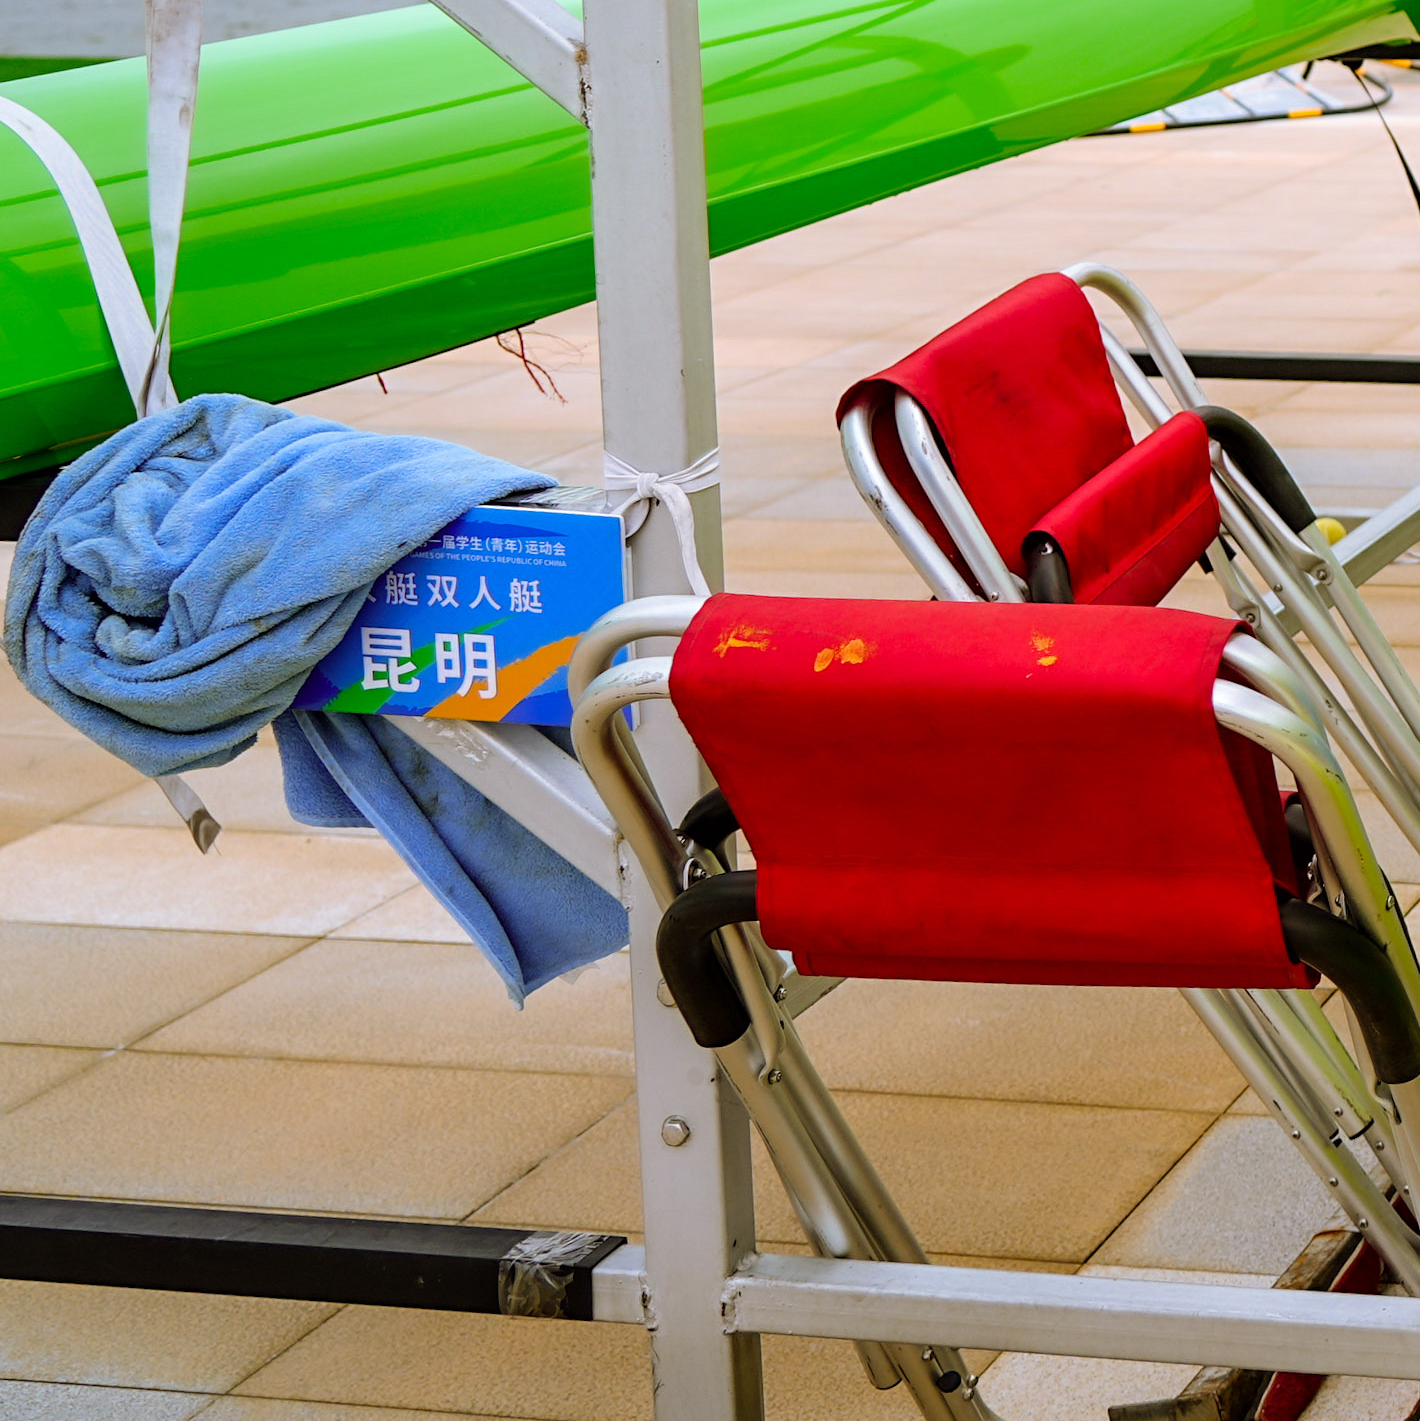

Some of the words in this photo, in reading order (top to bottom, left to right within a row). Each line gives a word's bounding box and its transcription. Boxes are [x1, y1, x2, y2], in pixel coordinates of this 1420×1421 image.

[366, 571, 543, 614] 艇双人艇
[360, 626, 498, 699] 昆明
